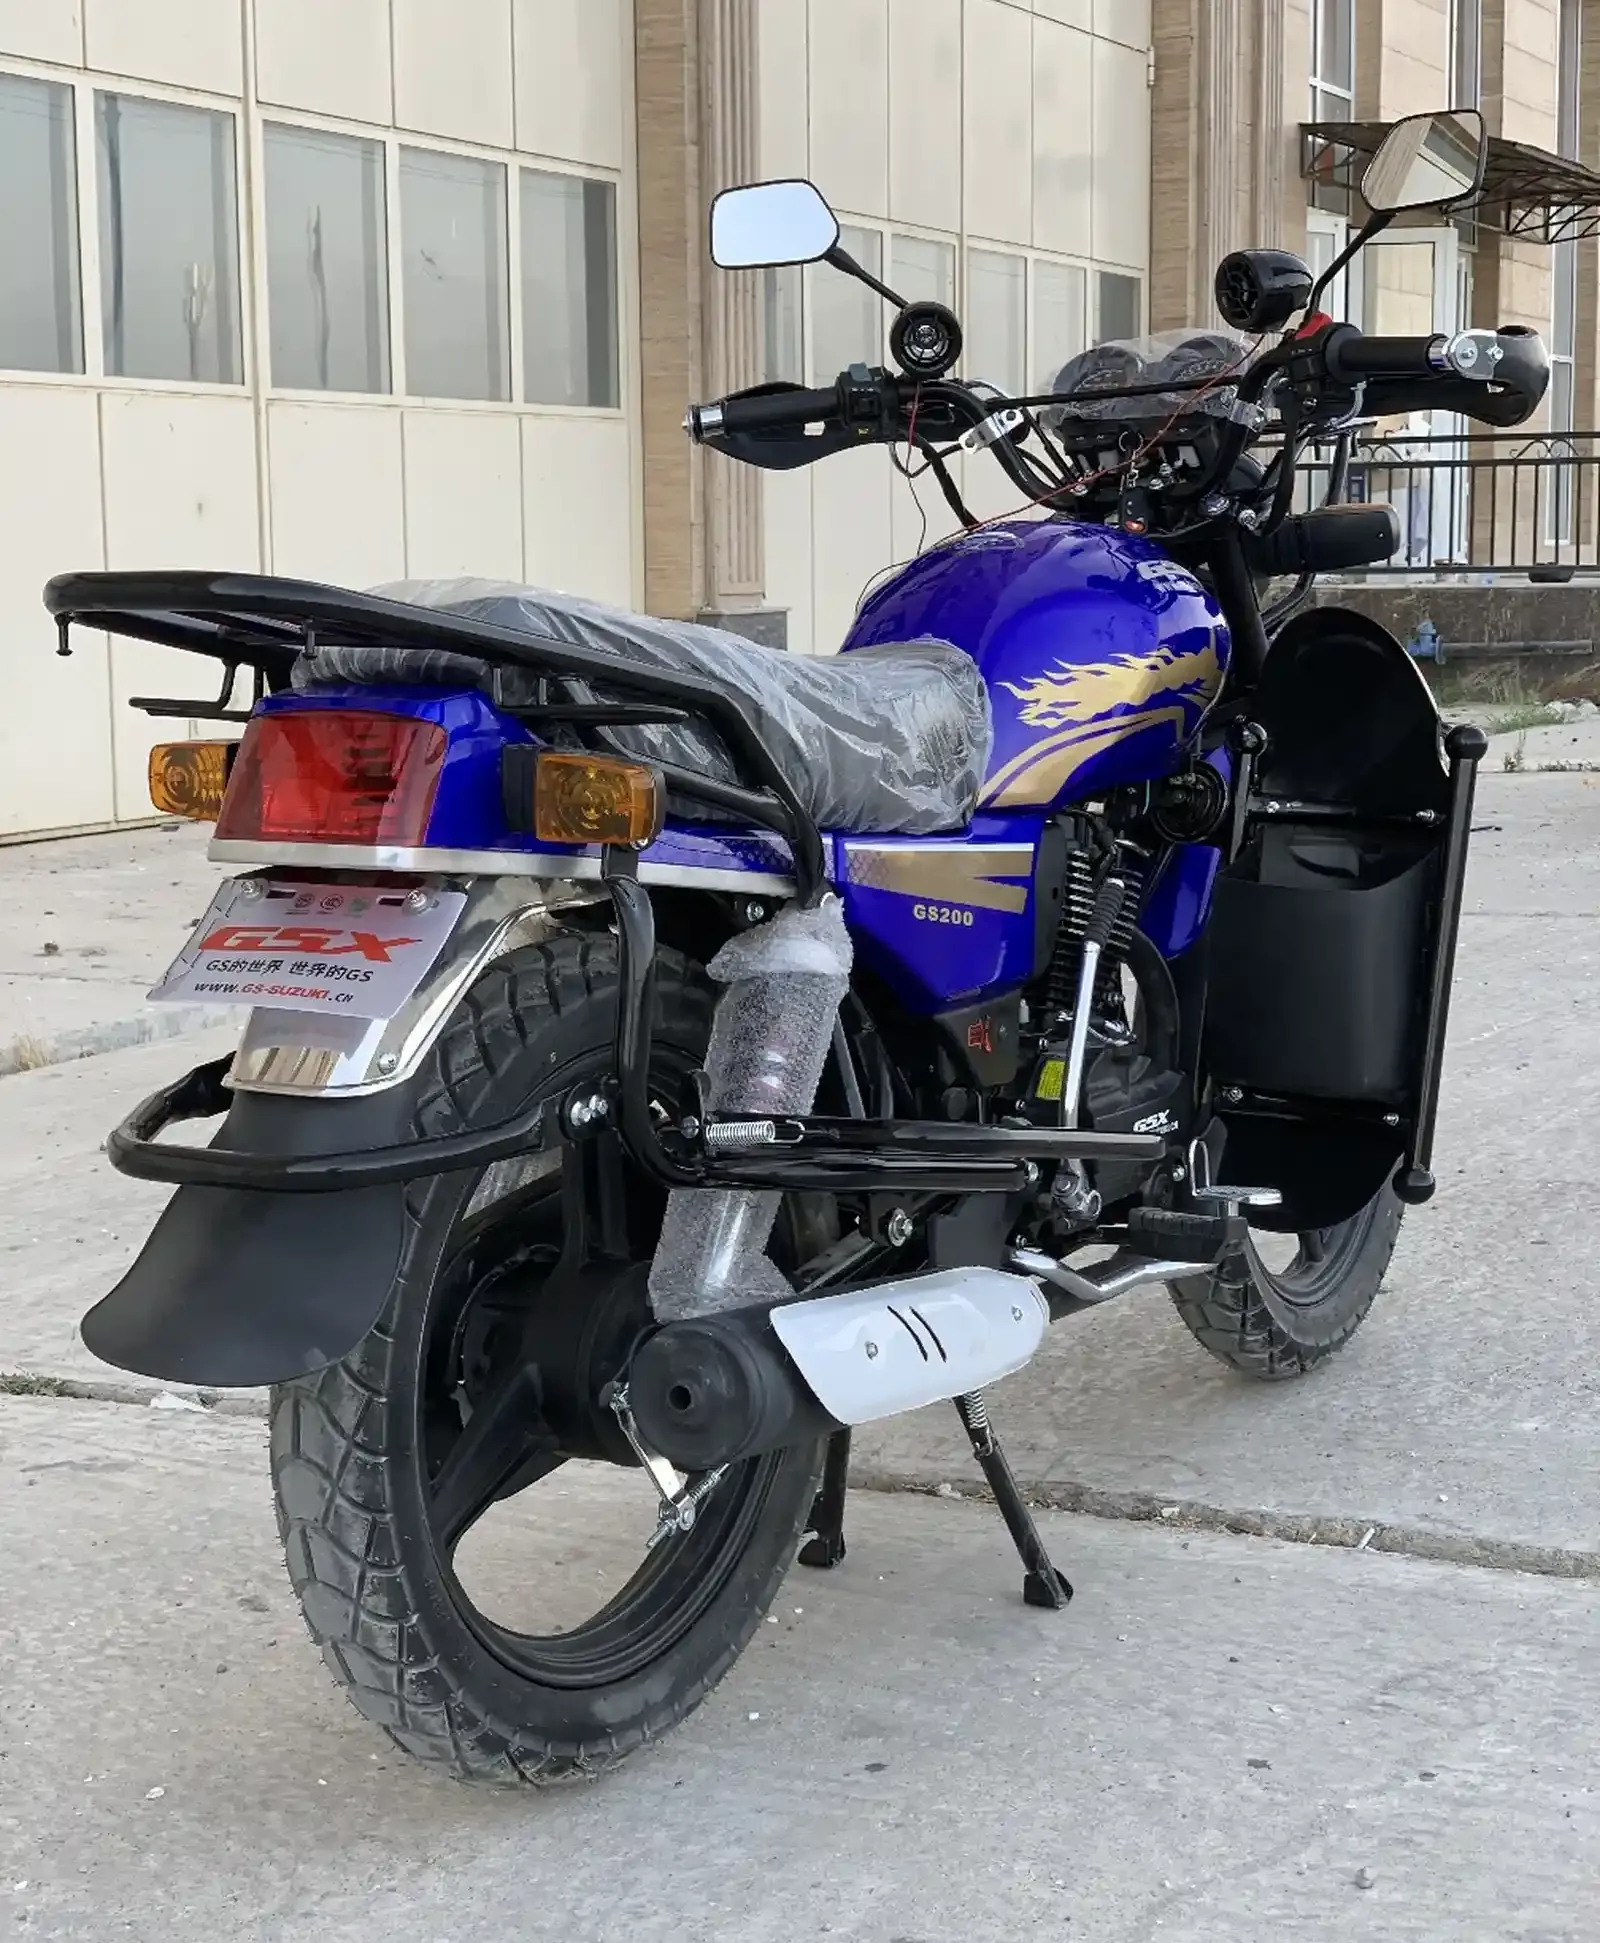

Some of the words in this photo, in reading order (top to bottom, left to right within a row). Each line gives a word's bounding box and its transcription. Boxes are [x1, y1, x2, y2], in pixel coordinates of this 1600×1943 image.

[913, 904, 974, 927] GS200
[199, 925, 422, 963] GSX
[206, 959, 284, 976] GS的世界
[288, 961, 373, 982] 世界的GS
[1133, 1109, 1170, 1132] GSX
